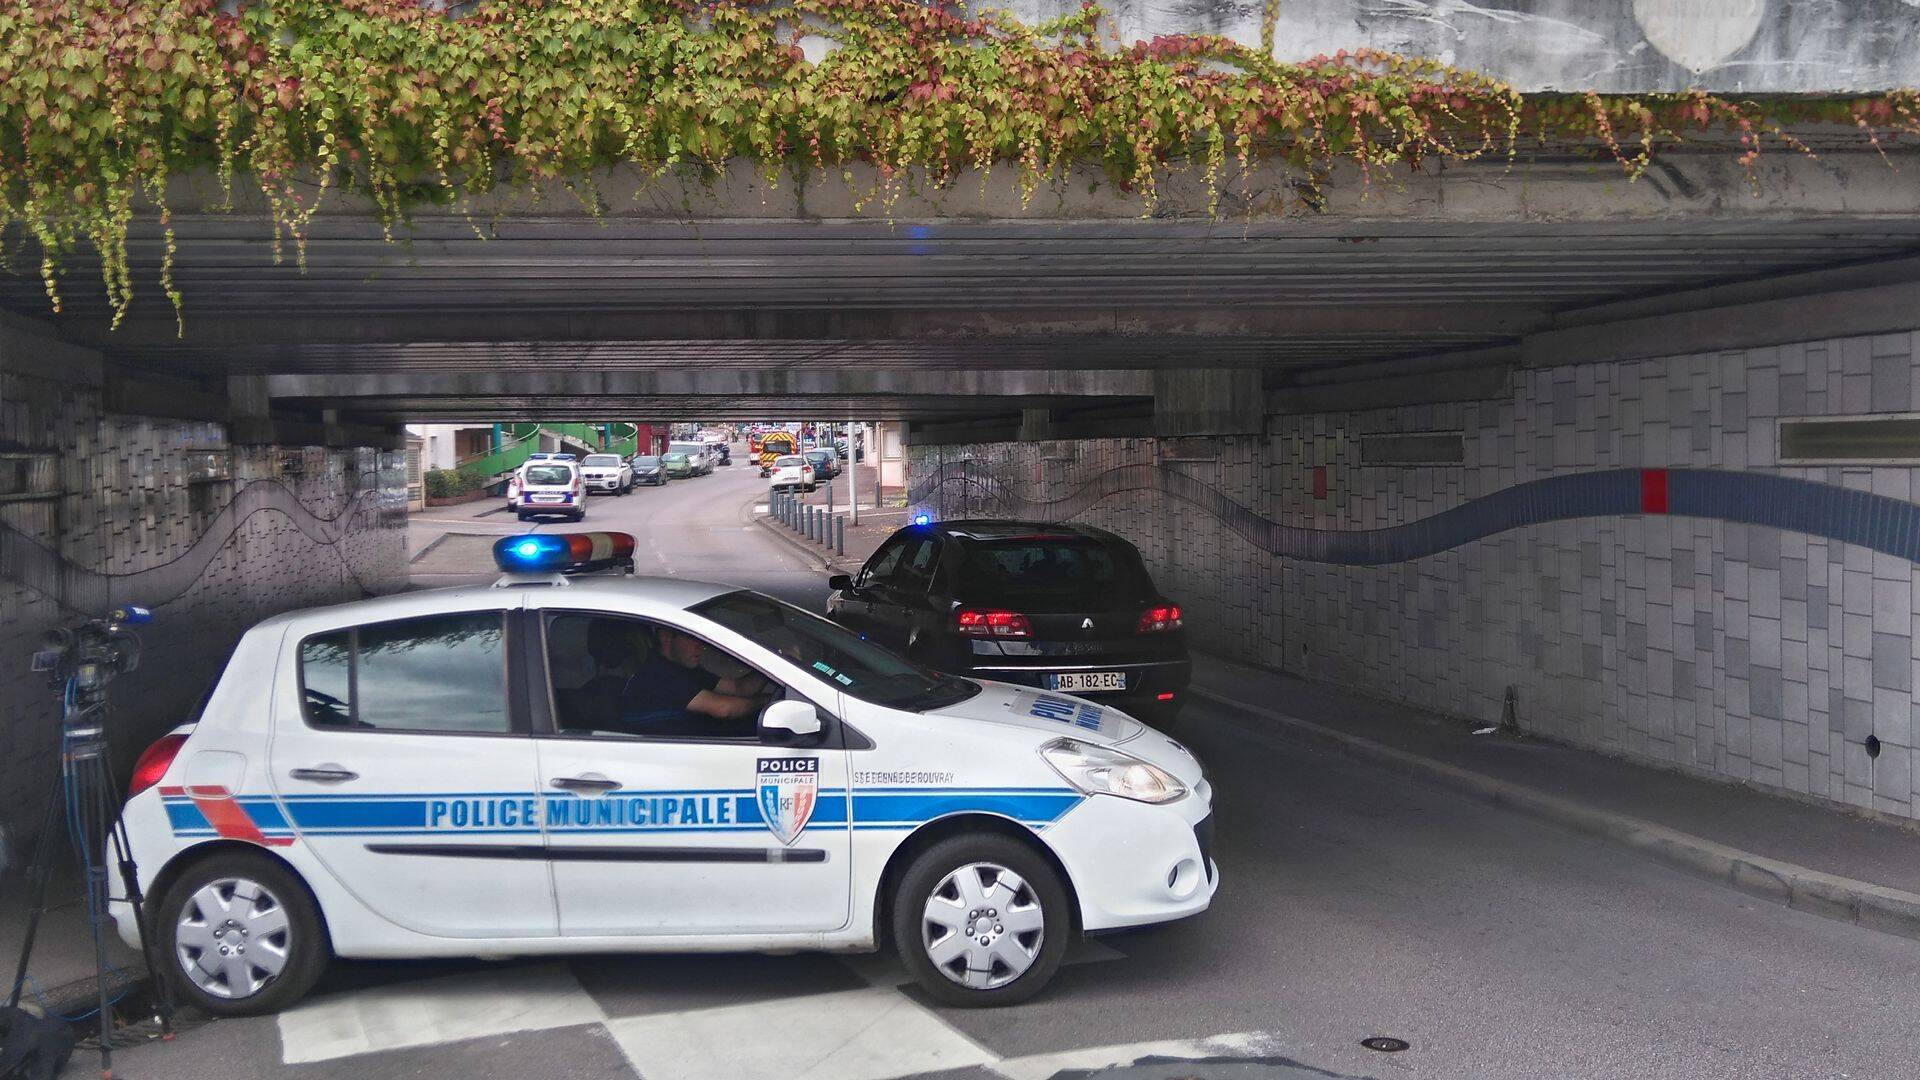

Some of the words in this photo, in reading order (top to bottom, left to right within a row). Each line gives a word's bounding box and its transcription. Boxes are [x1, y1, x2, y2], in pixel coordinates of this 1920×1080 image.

[1060, 674, 1117, 688] AB-182-EC
[760, 760, 815, 771] POLICE
[432, 800, 534, 827] POLICE
[547, 797, 731, 826] MUNICIPALE
